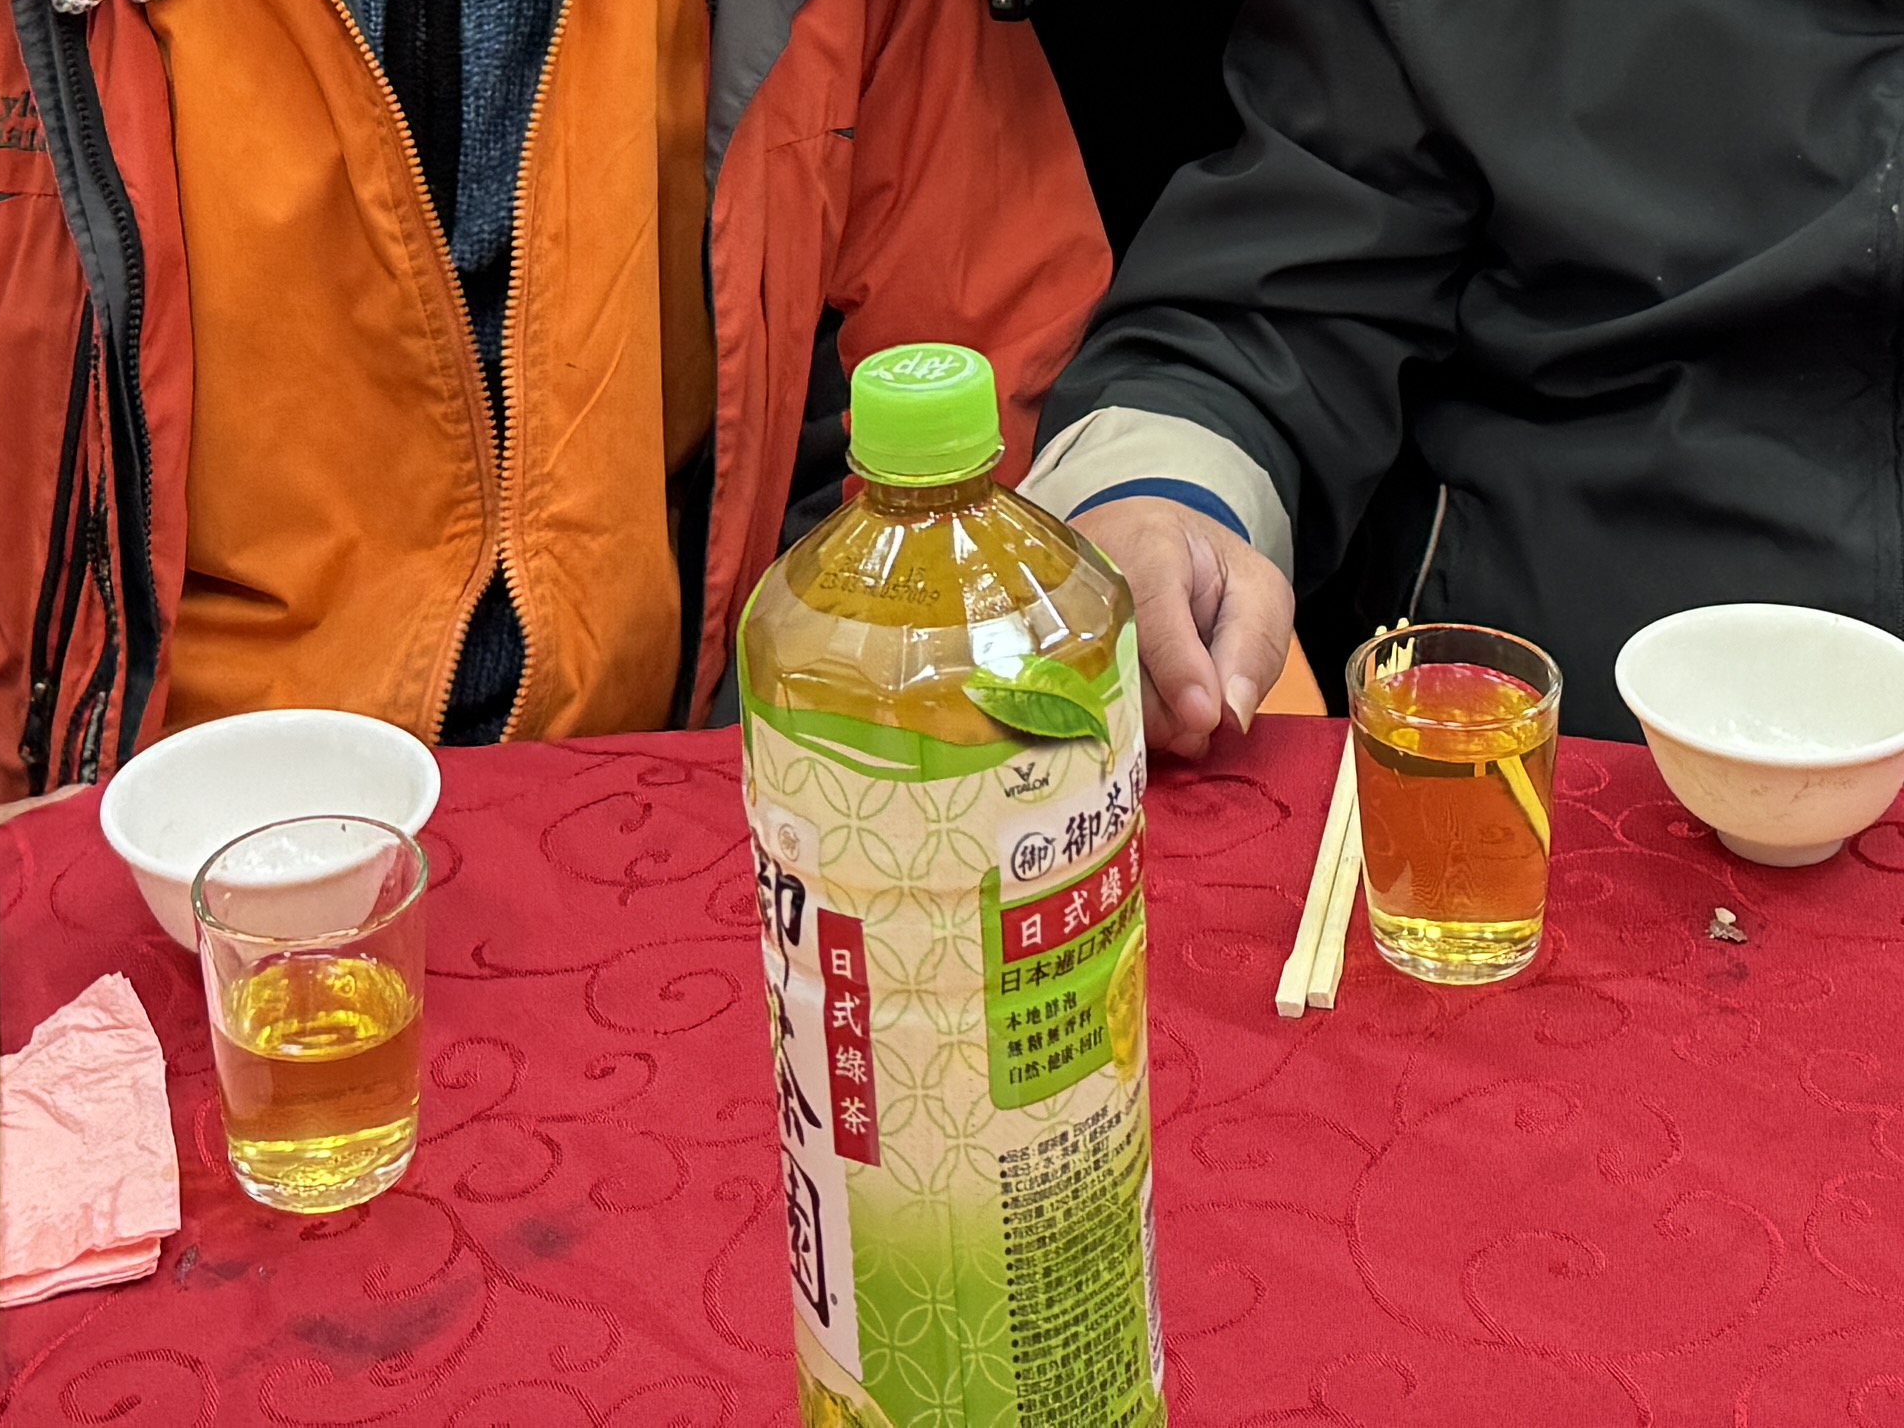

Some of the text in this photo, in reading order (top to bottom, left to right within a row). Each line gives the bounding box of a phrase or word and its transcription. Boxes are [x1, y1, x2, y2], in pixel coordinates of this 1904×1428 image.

[1003, 774, 1050, 799] VITALON
[829, 947, 871, 1136] 日式綠茶
